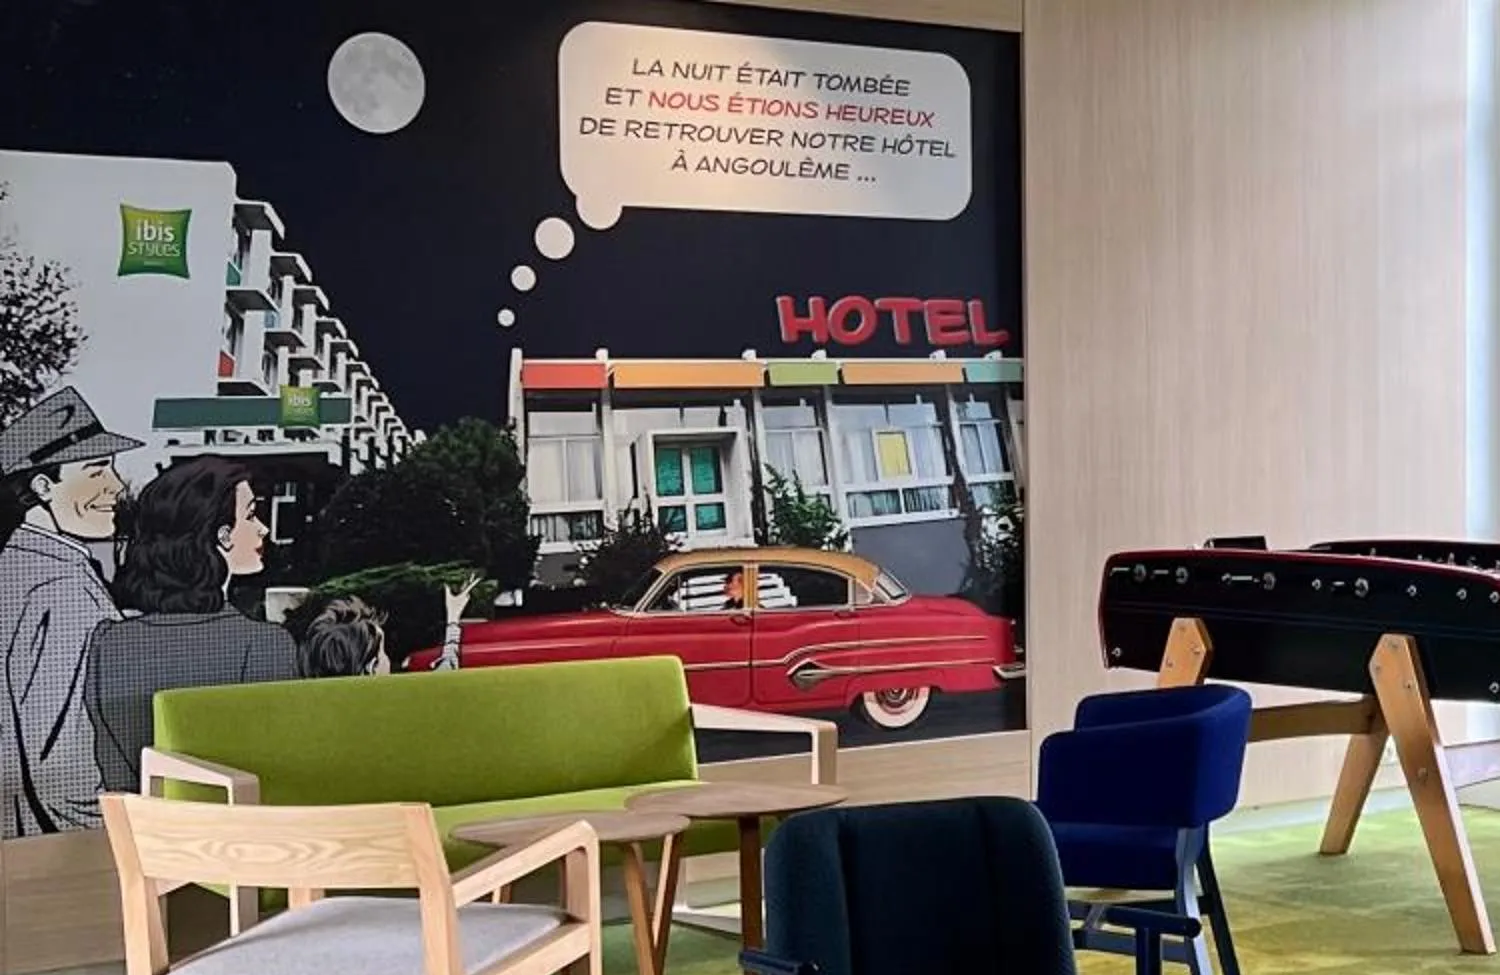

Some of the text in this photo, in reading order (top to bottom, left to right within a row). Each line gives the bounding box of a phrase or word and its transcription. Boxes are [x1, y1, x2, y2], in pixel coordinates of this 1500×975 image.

[632, 58, 911, 97] LA NUIT ÉTAIT TOMBÉE
[605, 87, 935, 128] ET NOUS ÉTIONS HEUREUX
[579, 117, 956, 158] DE RETROUVER NOTRE HÔTEL
[671, 150, 688, 171] À
[695, 155, 850, 181] ANGOULÊME
[136, 219, 175, 242] ibis
[776, 295, 1009, 346] HOTEL
